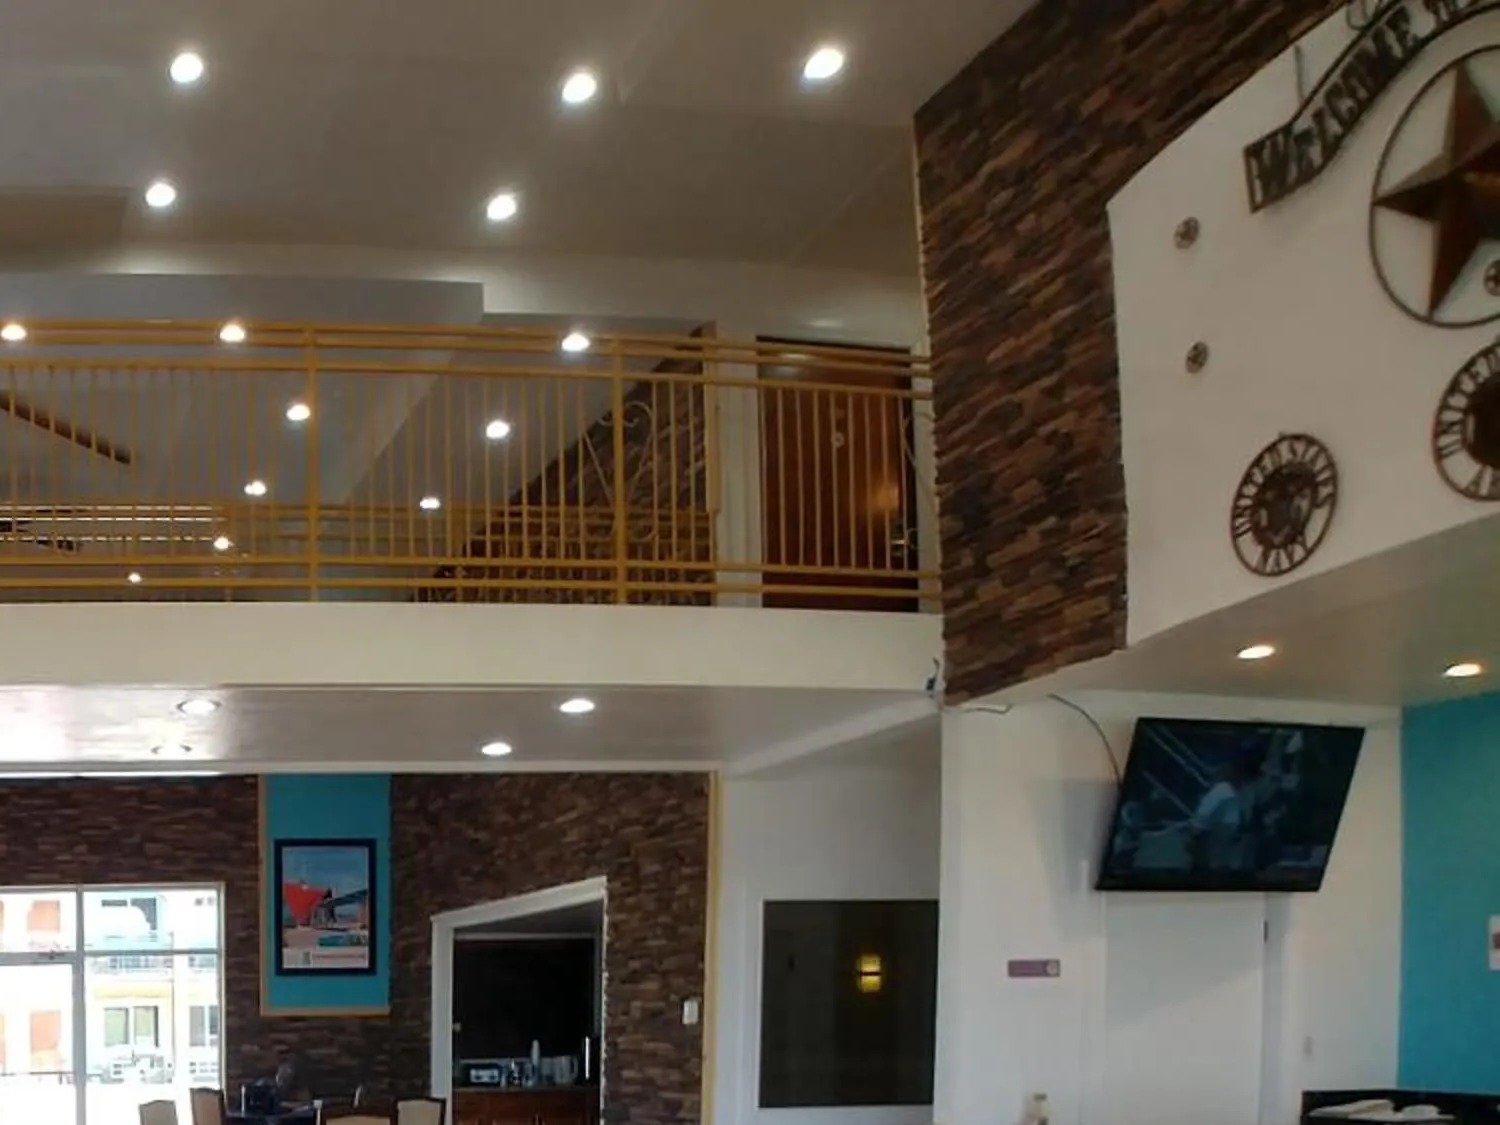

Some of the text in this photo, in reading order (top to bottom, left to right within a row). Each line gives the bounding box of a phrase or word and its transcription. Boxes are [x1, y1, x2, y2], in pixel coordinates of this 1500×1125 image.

[1234, 437, 1334, 538] UNITED STATES
[1252, 531, 1308, 573] NAVY
